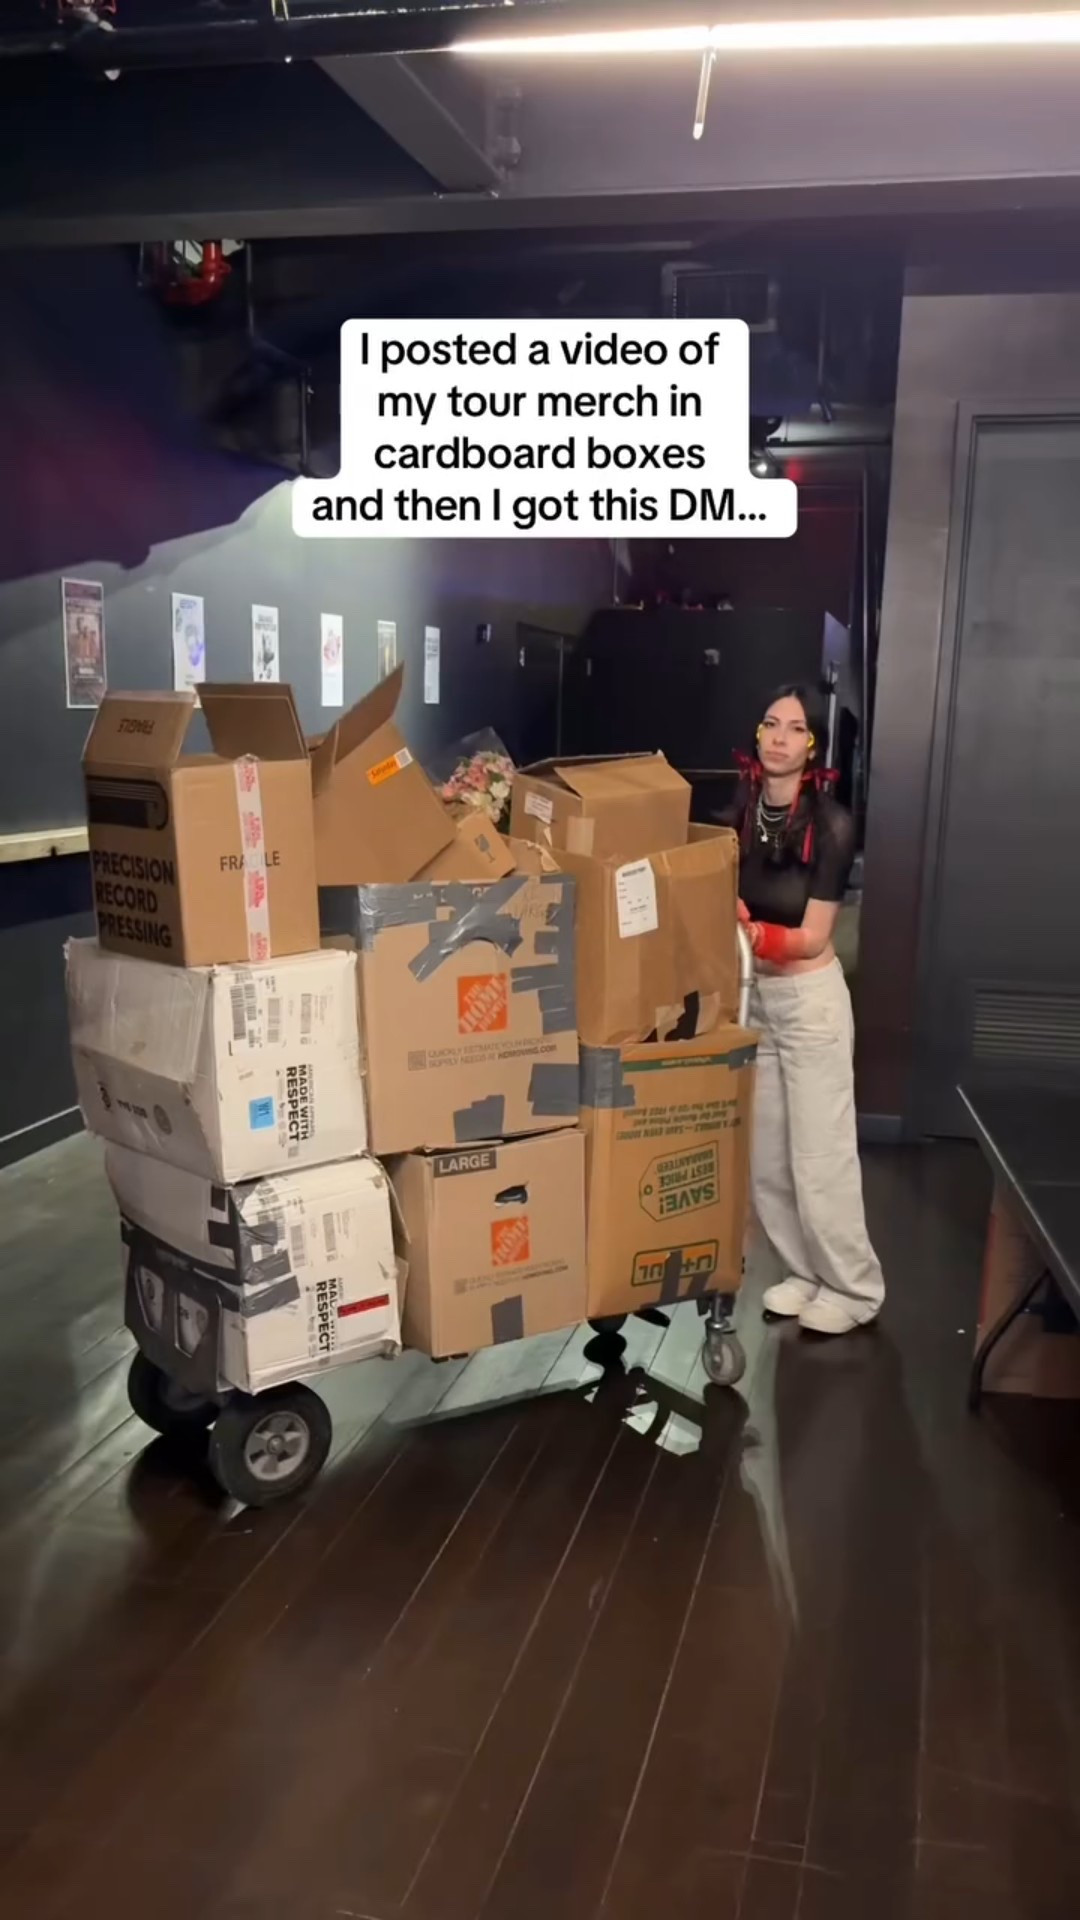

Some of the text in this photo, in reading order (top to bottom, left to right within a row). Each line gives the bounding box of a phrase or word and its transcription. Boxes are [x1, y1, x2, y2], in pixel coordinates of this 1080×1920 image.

[93, 850, 175, 887] PRECISION
[220, 850, 281, 872] FRALE
[96, 881, 158, 913] RECORD
[97, 911, 172, 947] PRESSING
[287, 1066, 300, 1142] RESPECT
[298, 1063, 309, 1141] MADE WITH
[438, 1152, 492, 1174] LARGE
[659, 1182, 715, 1215] SAVE!
[316, 1280, 330, 1353] RESPECT
